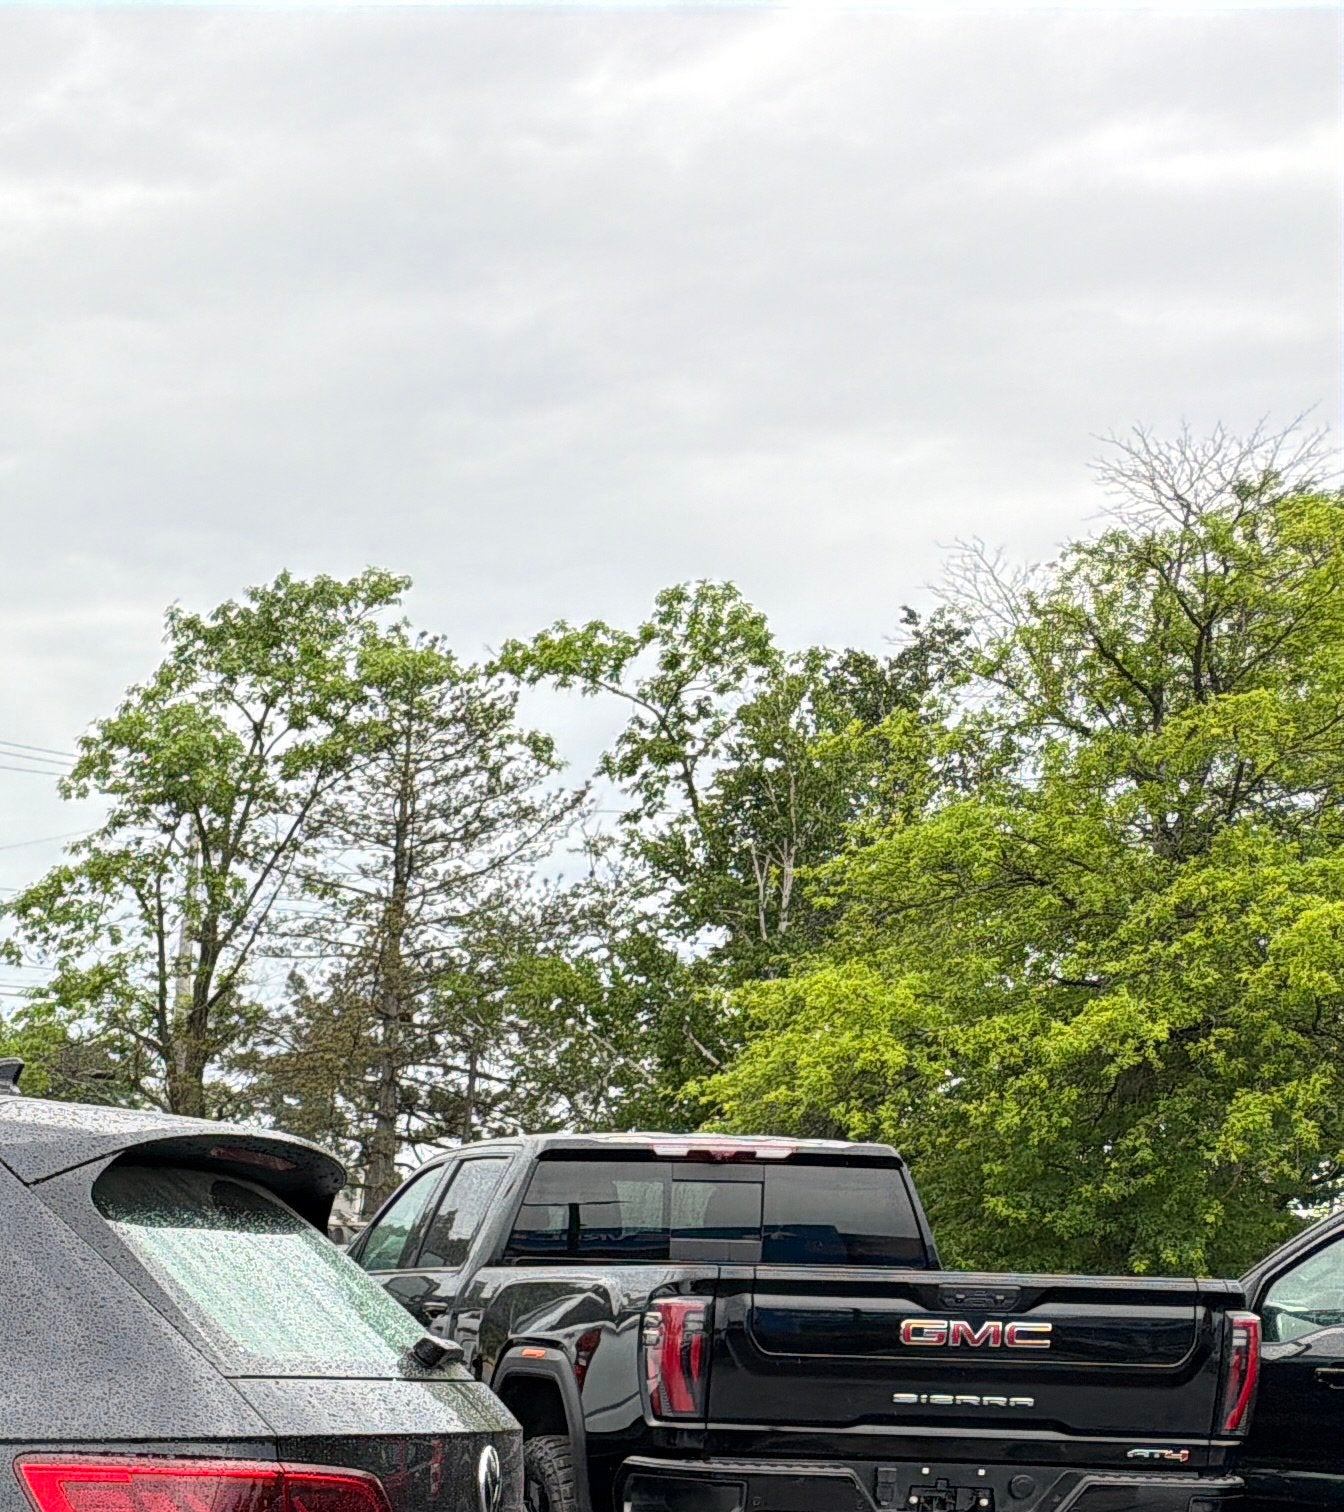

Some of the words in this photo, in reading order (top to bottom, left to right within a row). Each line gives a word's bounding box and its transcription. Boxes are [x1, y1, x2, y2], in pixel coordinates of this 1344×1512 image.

[899, 1318, 1053, 1349] GMC
[892, 1392, 1035, 1407] SIERRA
[1126, 1448, 1190, 1462] AT4
